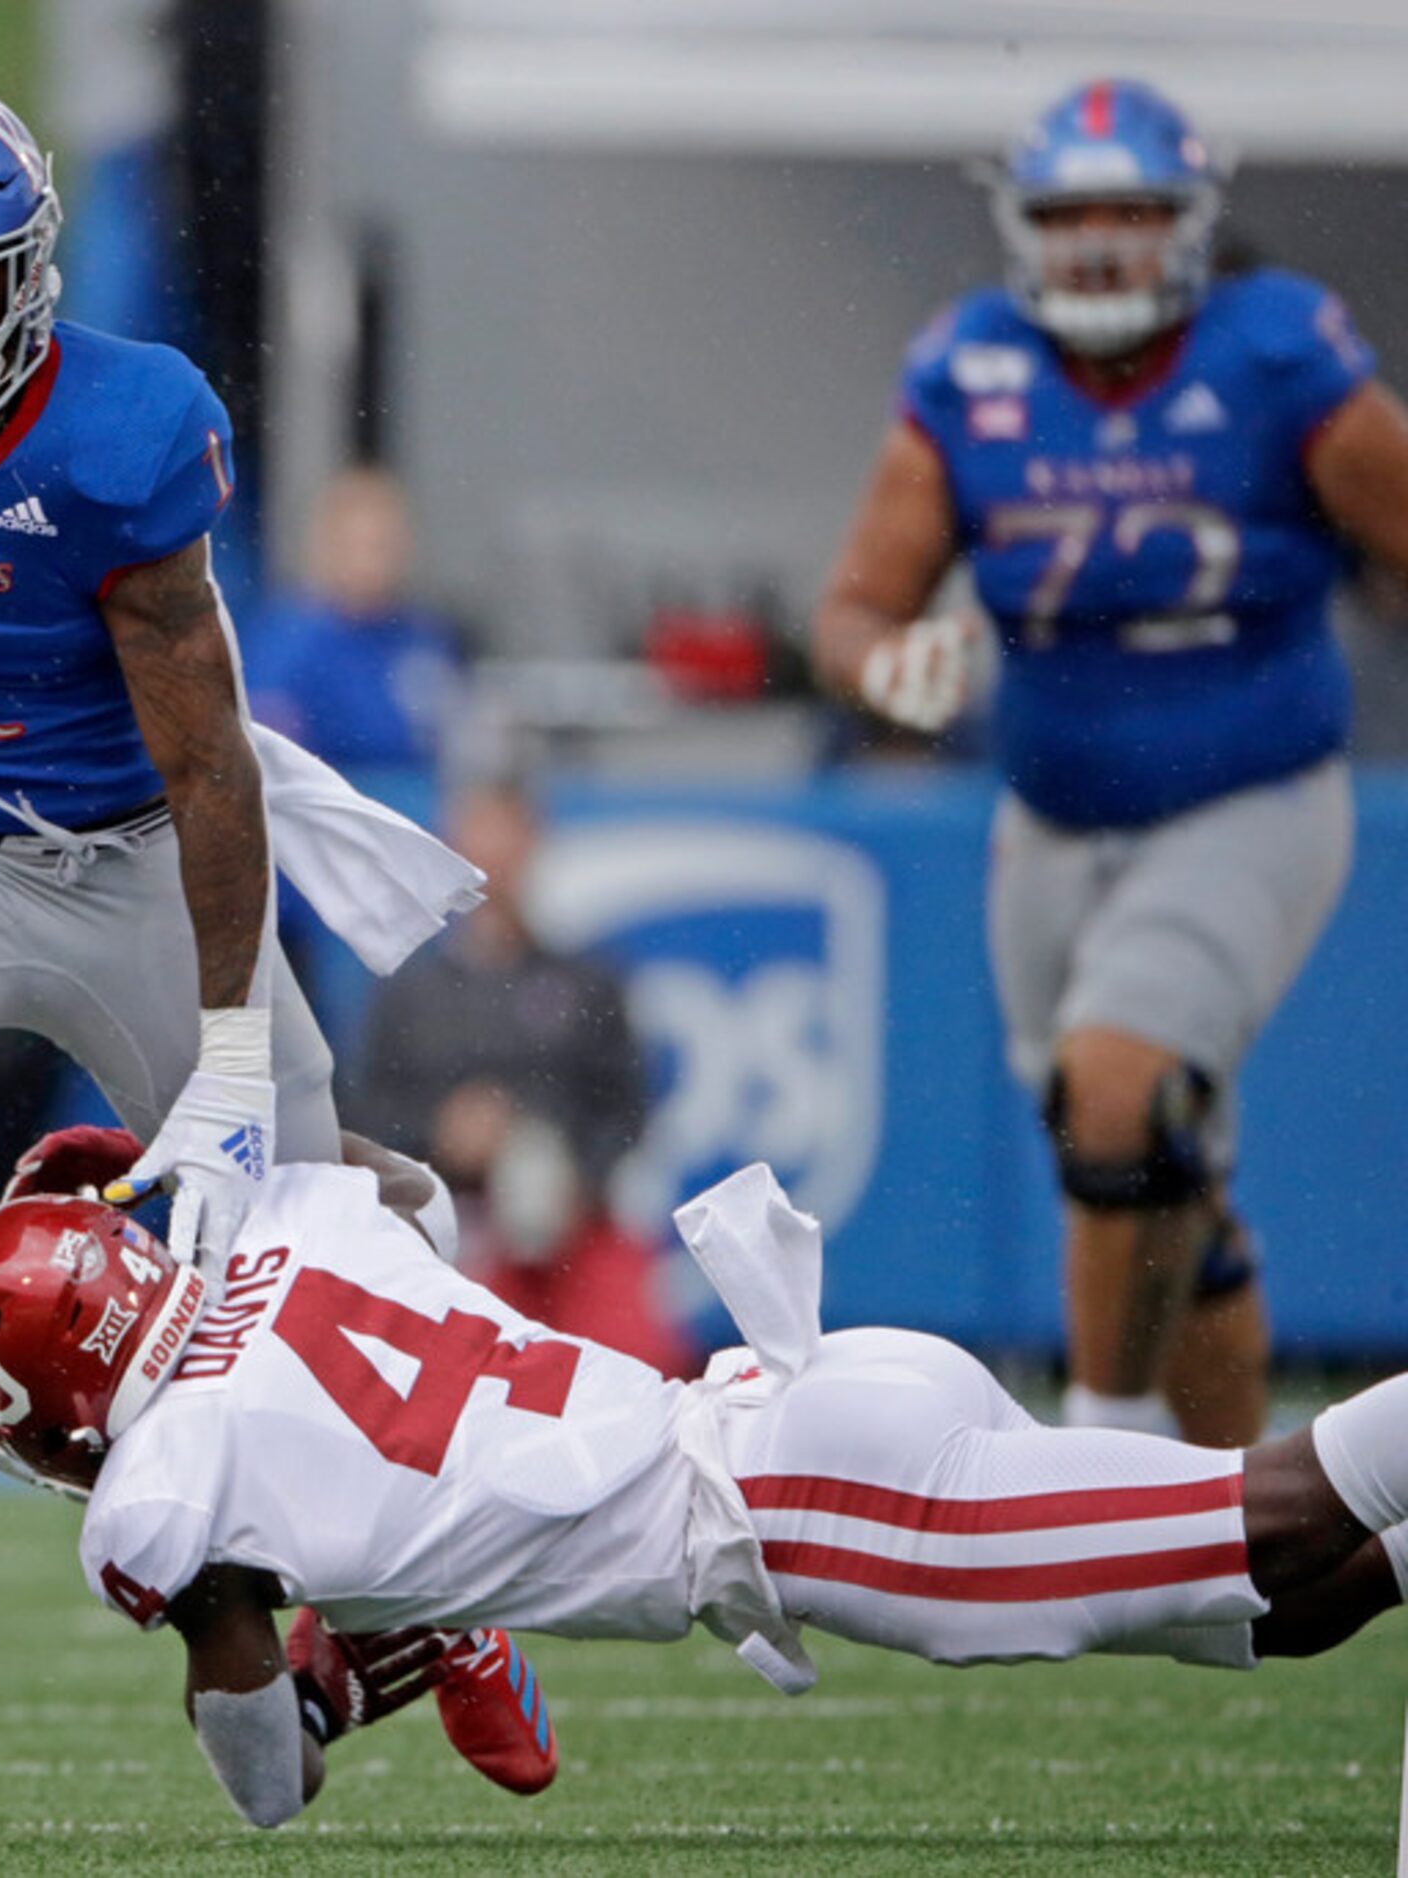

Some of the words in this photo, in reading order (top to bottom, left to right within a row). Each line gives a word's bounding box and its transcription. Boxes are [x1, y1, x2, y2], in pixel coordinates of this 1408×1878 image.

[984, 502, 1240, 652] 72
[120, 1247, 163, 1284] 4
[171, 1246, 290, 1382] DAVIS
[271, 1266, 583, 1478] 4
[100, 1559, 166, 1627] 4
